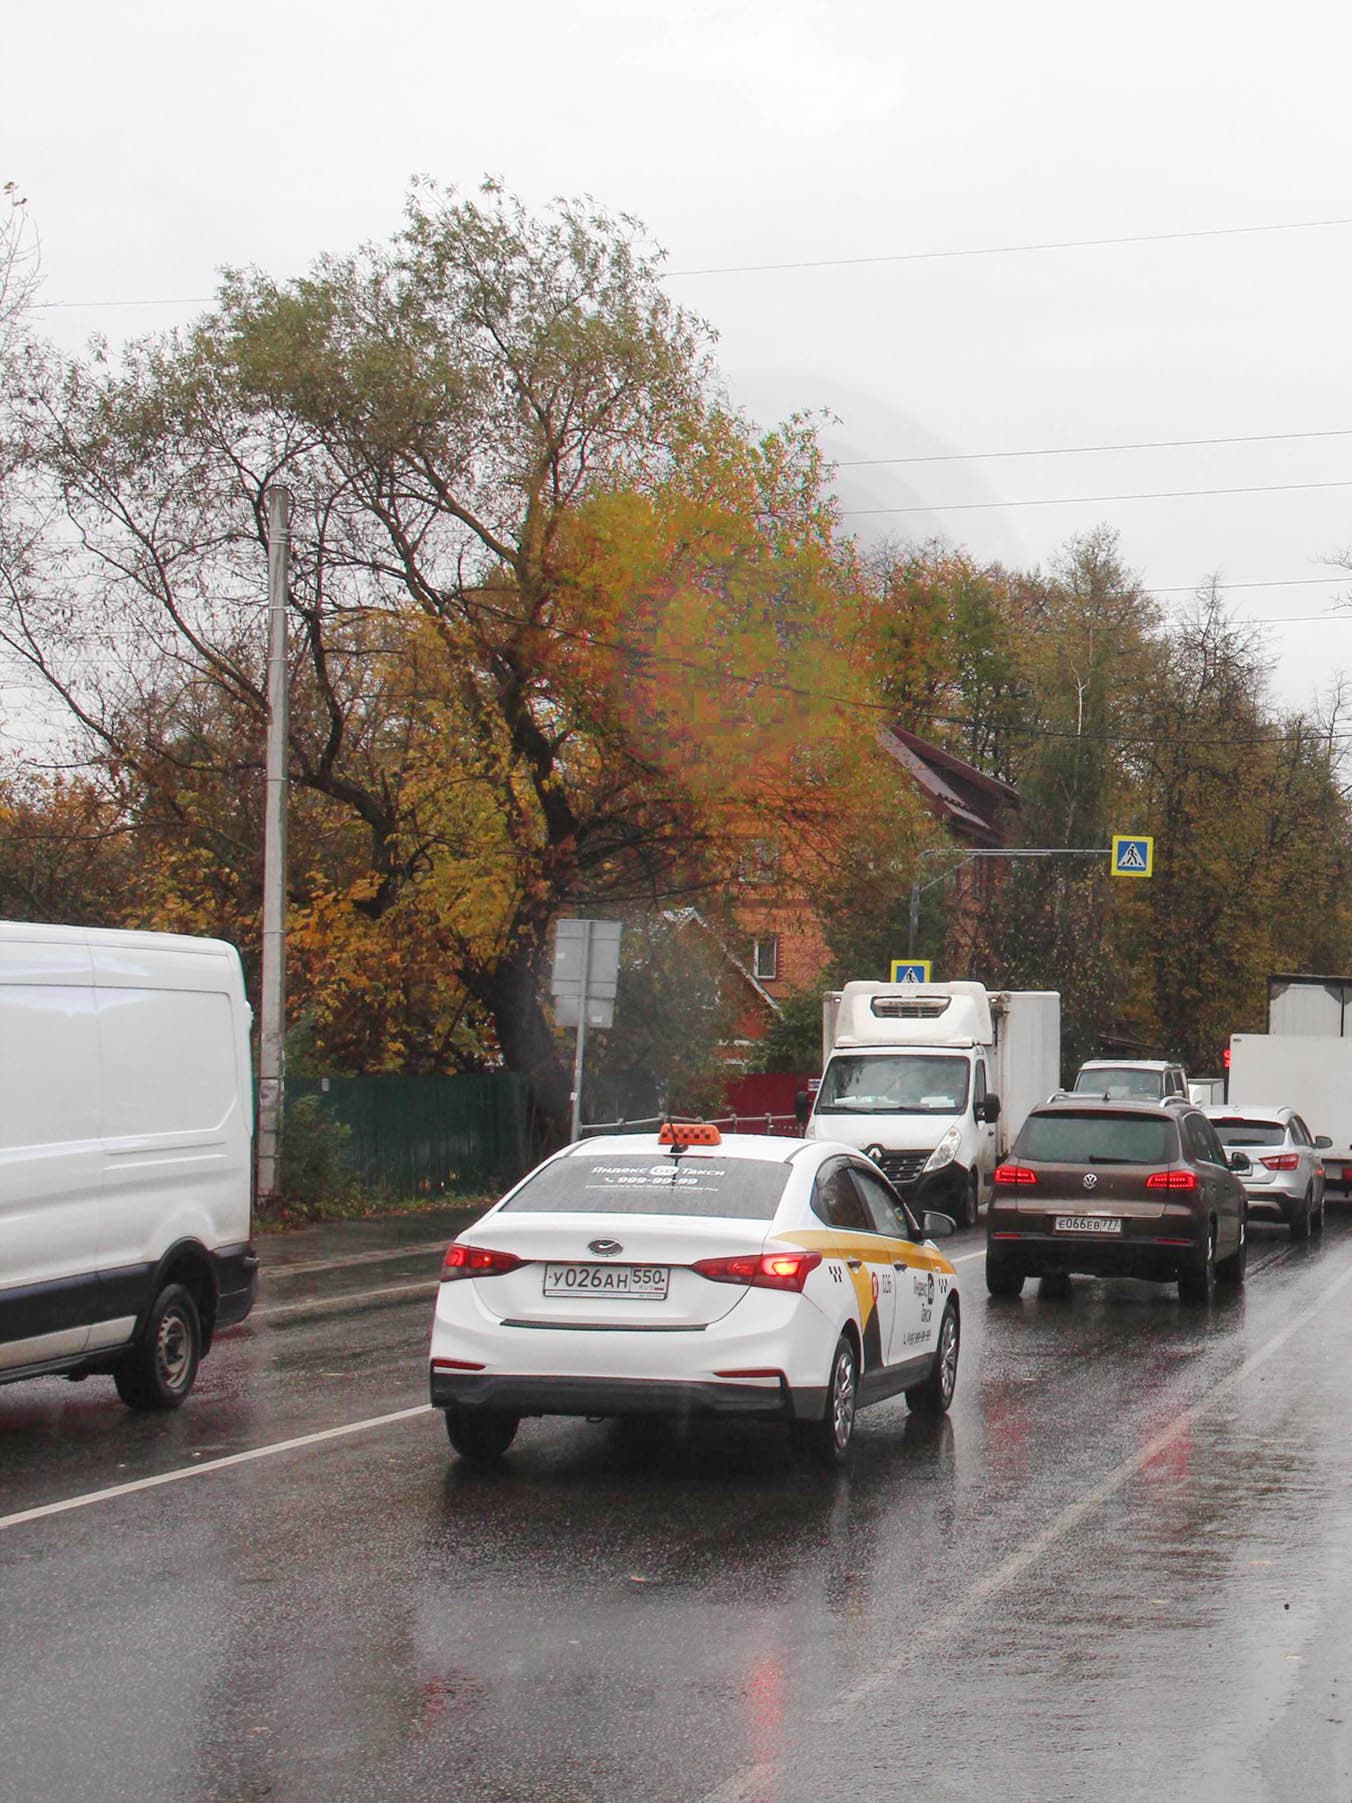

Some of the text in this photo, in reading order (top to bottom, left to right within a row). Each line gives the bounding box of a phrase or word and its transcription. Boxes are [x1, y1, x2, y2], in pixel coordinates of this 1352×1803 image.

[591, 1166, 648, 1174] Яндекс
[682, 1167, 726, 1176] Такси
[617, 1176, 698, 1185] 999-99-99
[553, 1268, 662, 1288] У026АН 550
